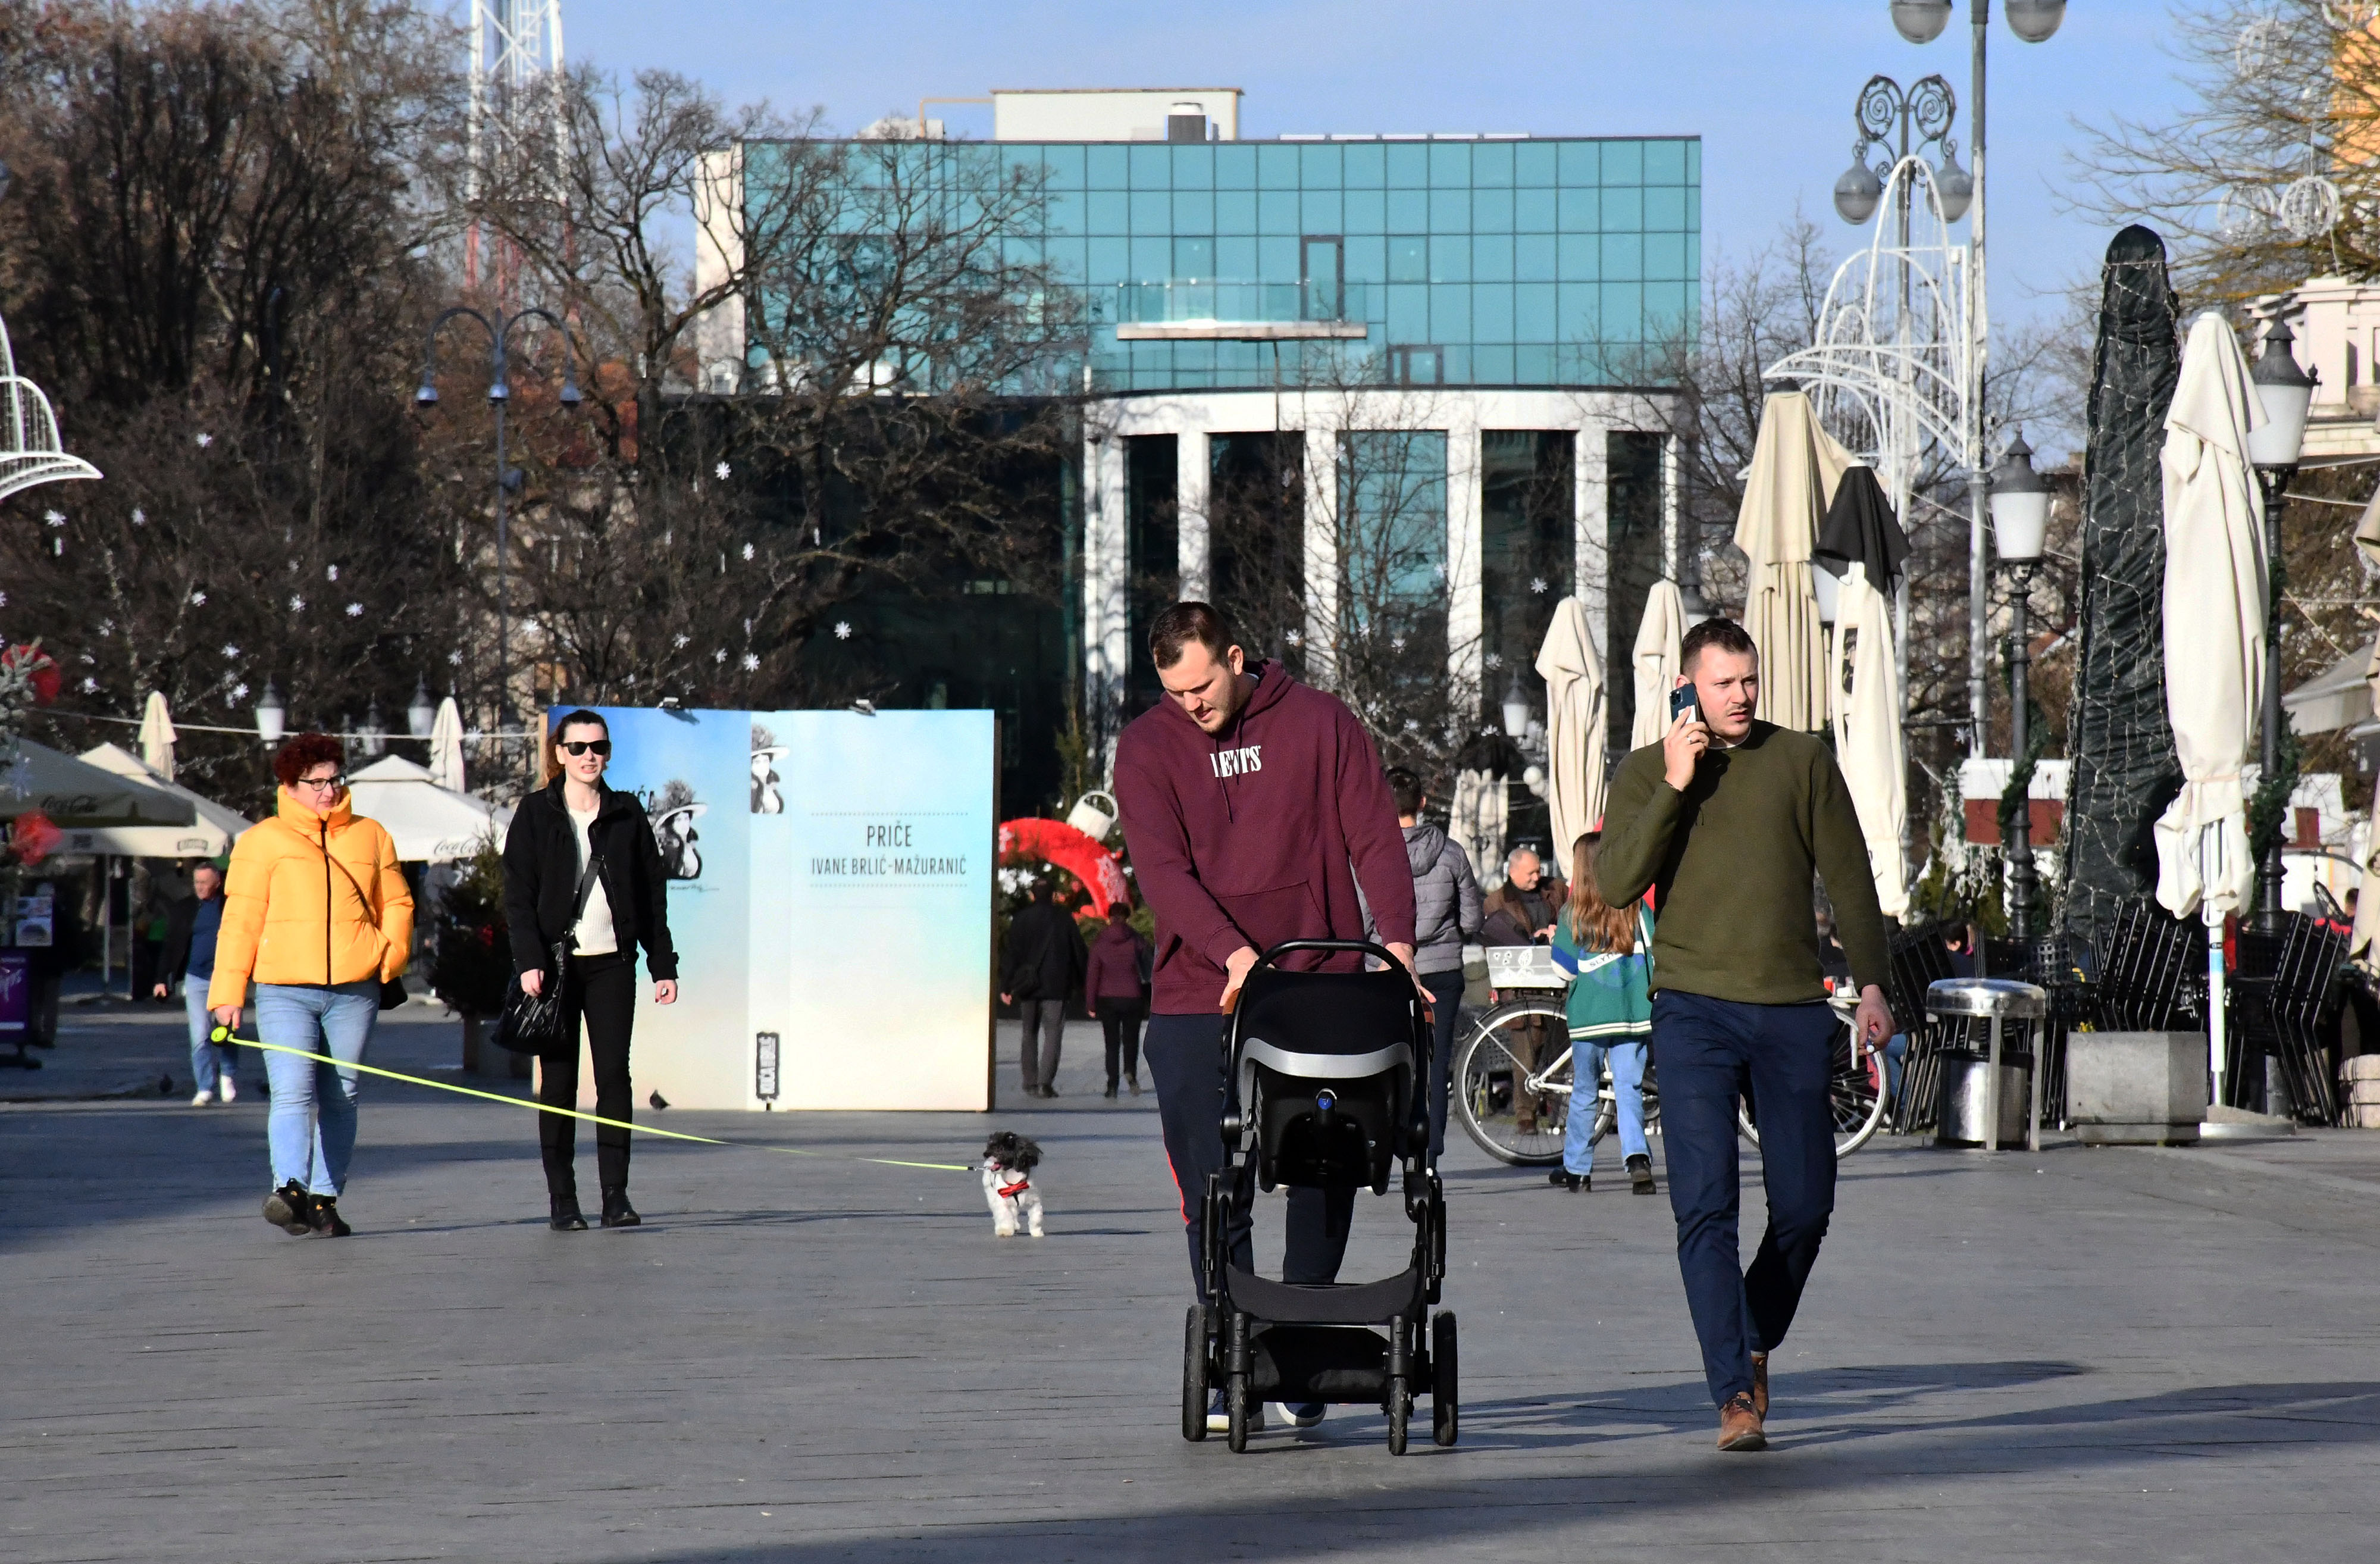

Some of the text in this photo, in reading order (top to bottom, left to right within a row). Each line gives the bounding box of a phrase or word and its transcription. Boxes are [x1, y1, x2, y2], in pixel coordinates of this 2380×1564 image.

[866, 820, 912, 847] PRIČE
[812, 853, 967, 875] IVANE BRLIĆ-MAŽURANIĆ
